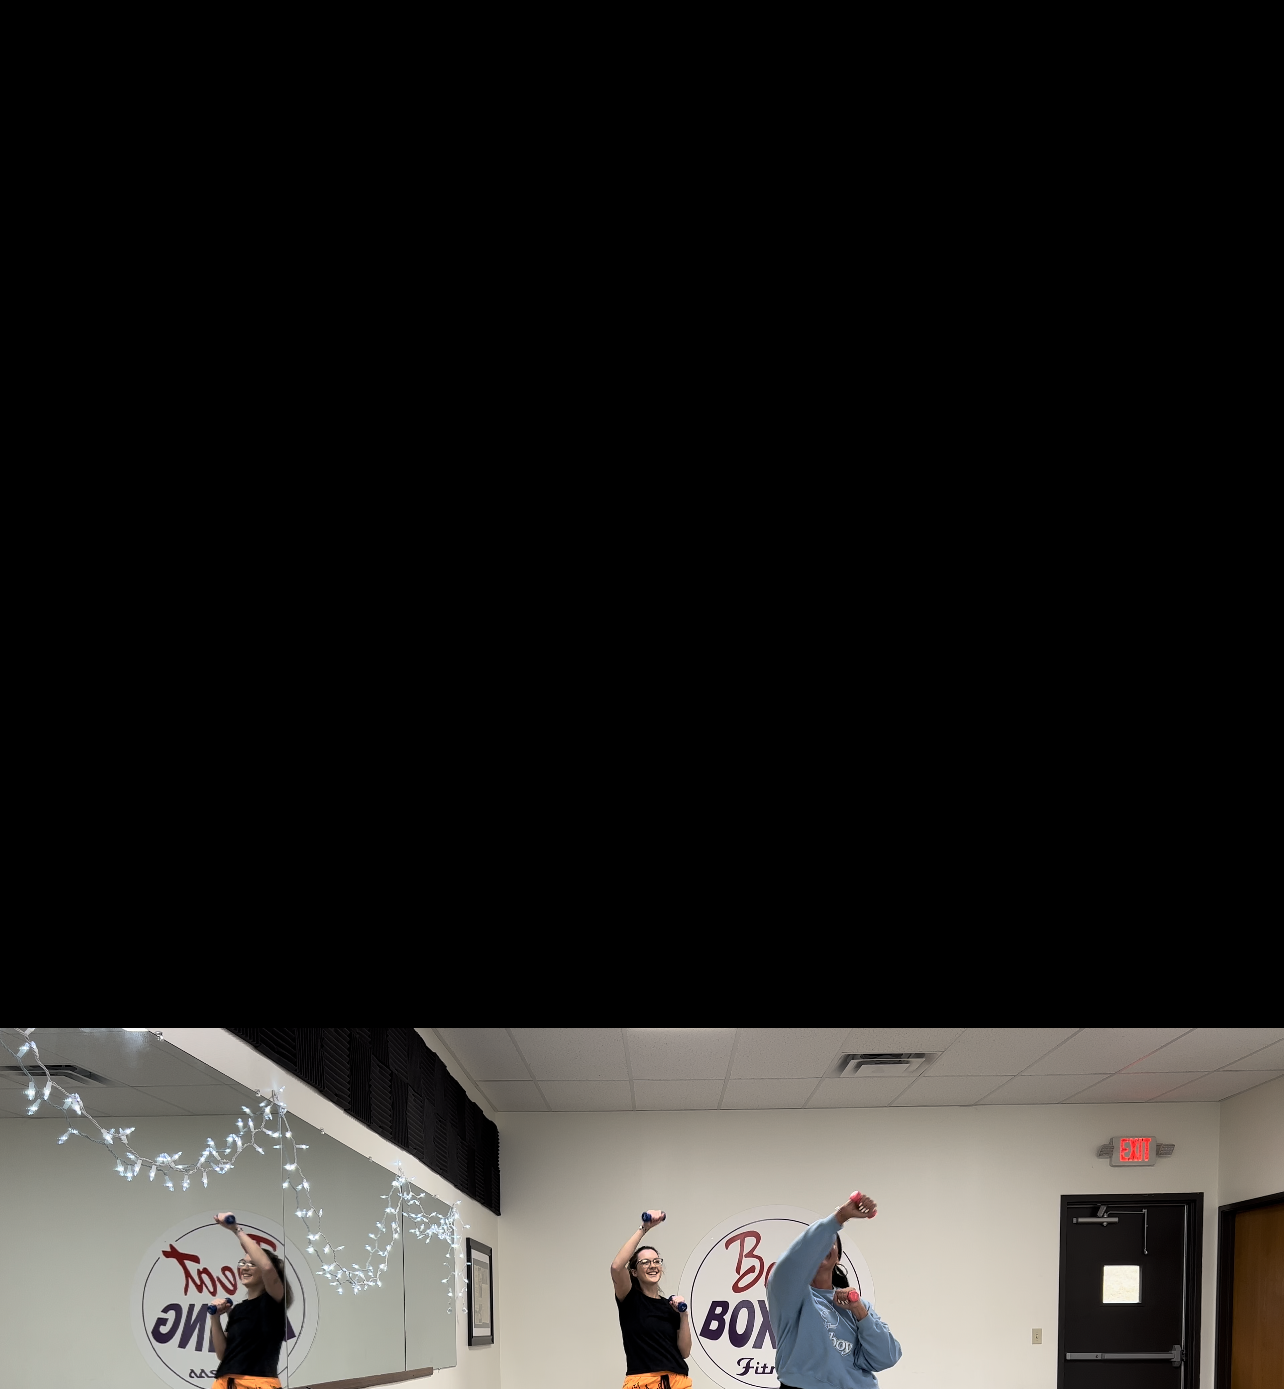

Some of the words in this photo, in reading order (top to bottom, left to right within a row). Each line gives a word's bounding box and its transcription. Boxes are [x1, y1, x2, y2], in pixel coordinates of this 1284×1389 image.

[1119, 1137, 1152, 1162] EXIT
[699, 1299, 777, 1349] BOX
[829, 1332, 853, 1357] boy
